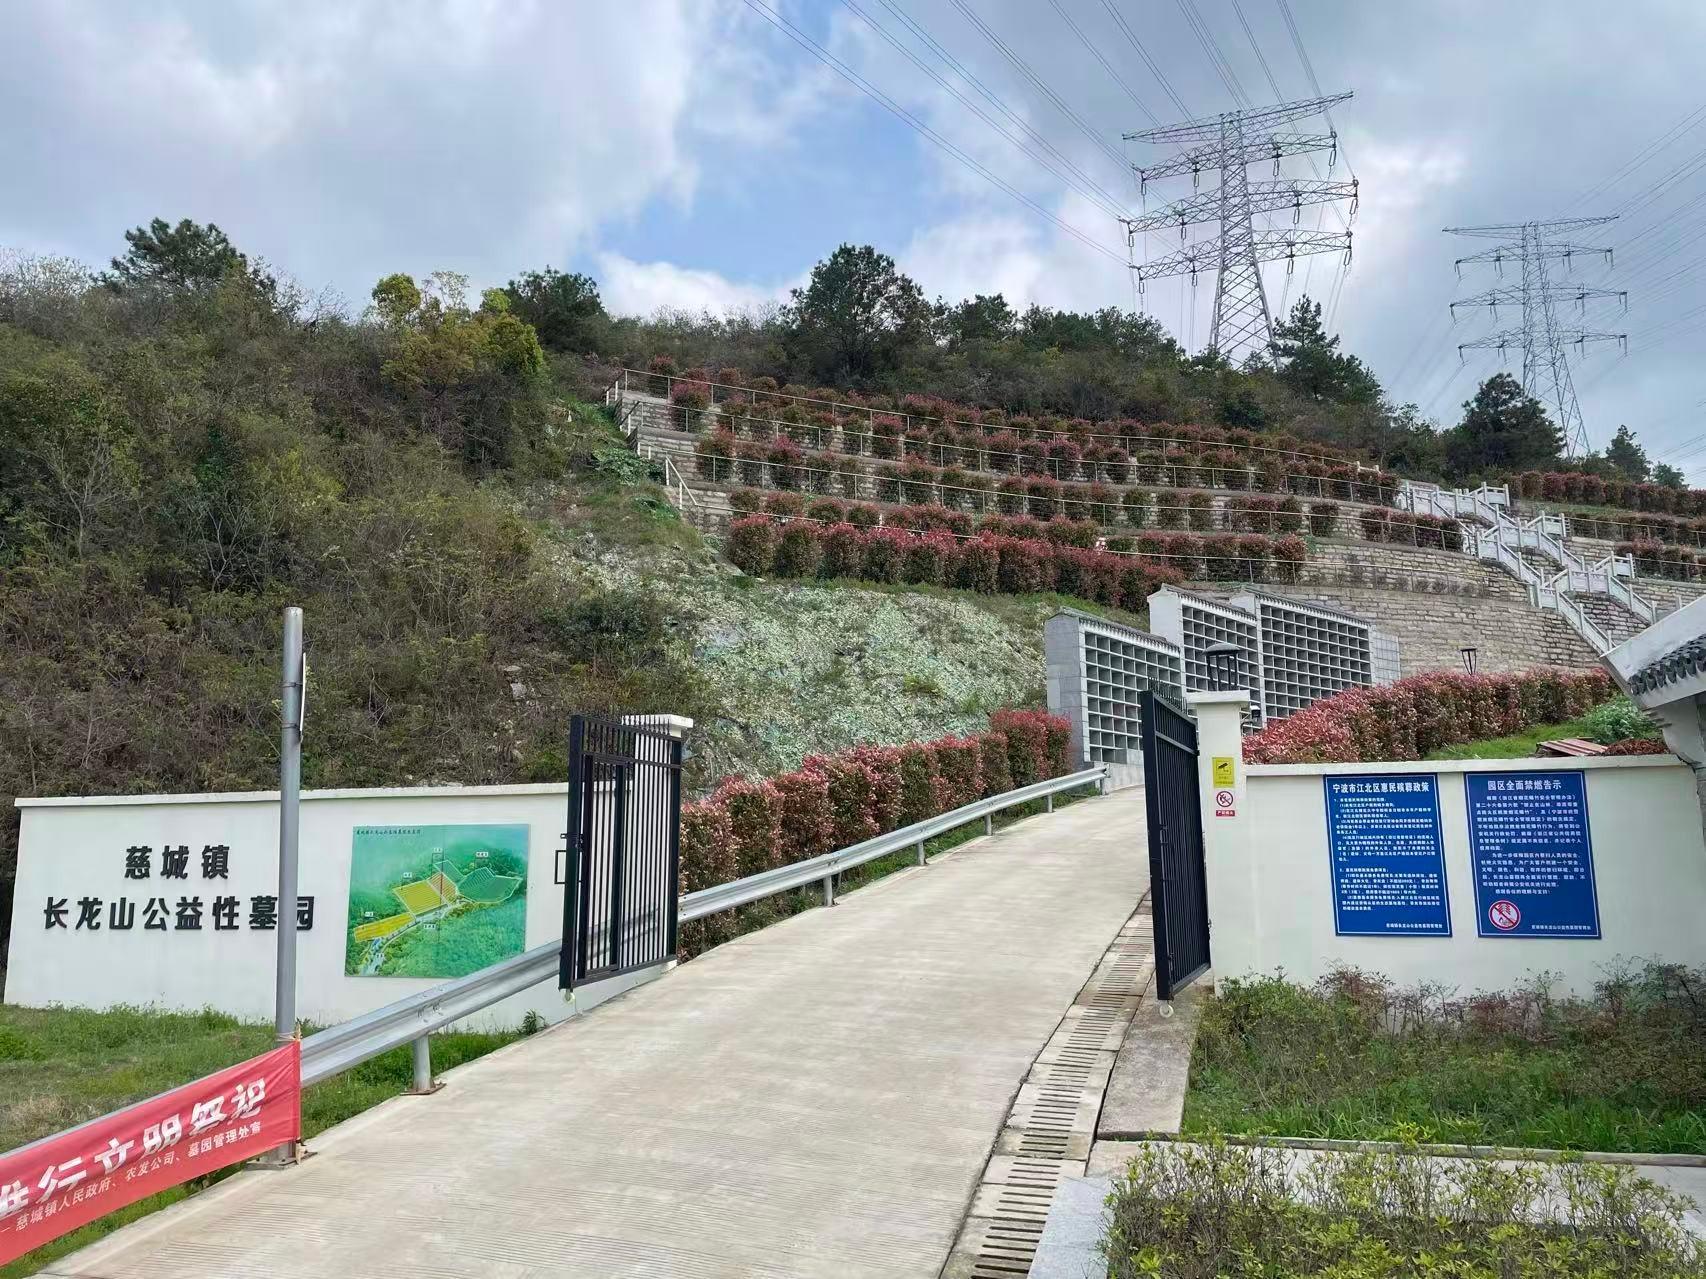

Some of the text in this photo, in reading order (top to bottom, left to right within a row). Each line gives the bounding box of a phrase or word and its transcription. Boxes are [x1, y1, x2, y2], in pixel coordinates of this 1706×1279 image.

[1487, 779, 1562, 791] 园区全面禁燃告示
[125, 845, 230, 880] 慈城镇
[44, 896, 314, 931] 长龙山公益性墓园
